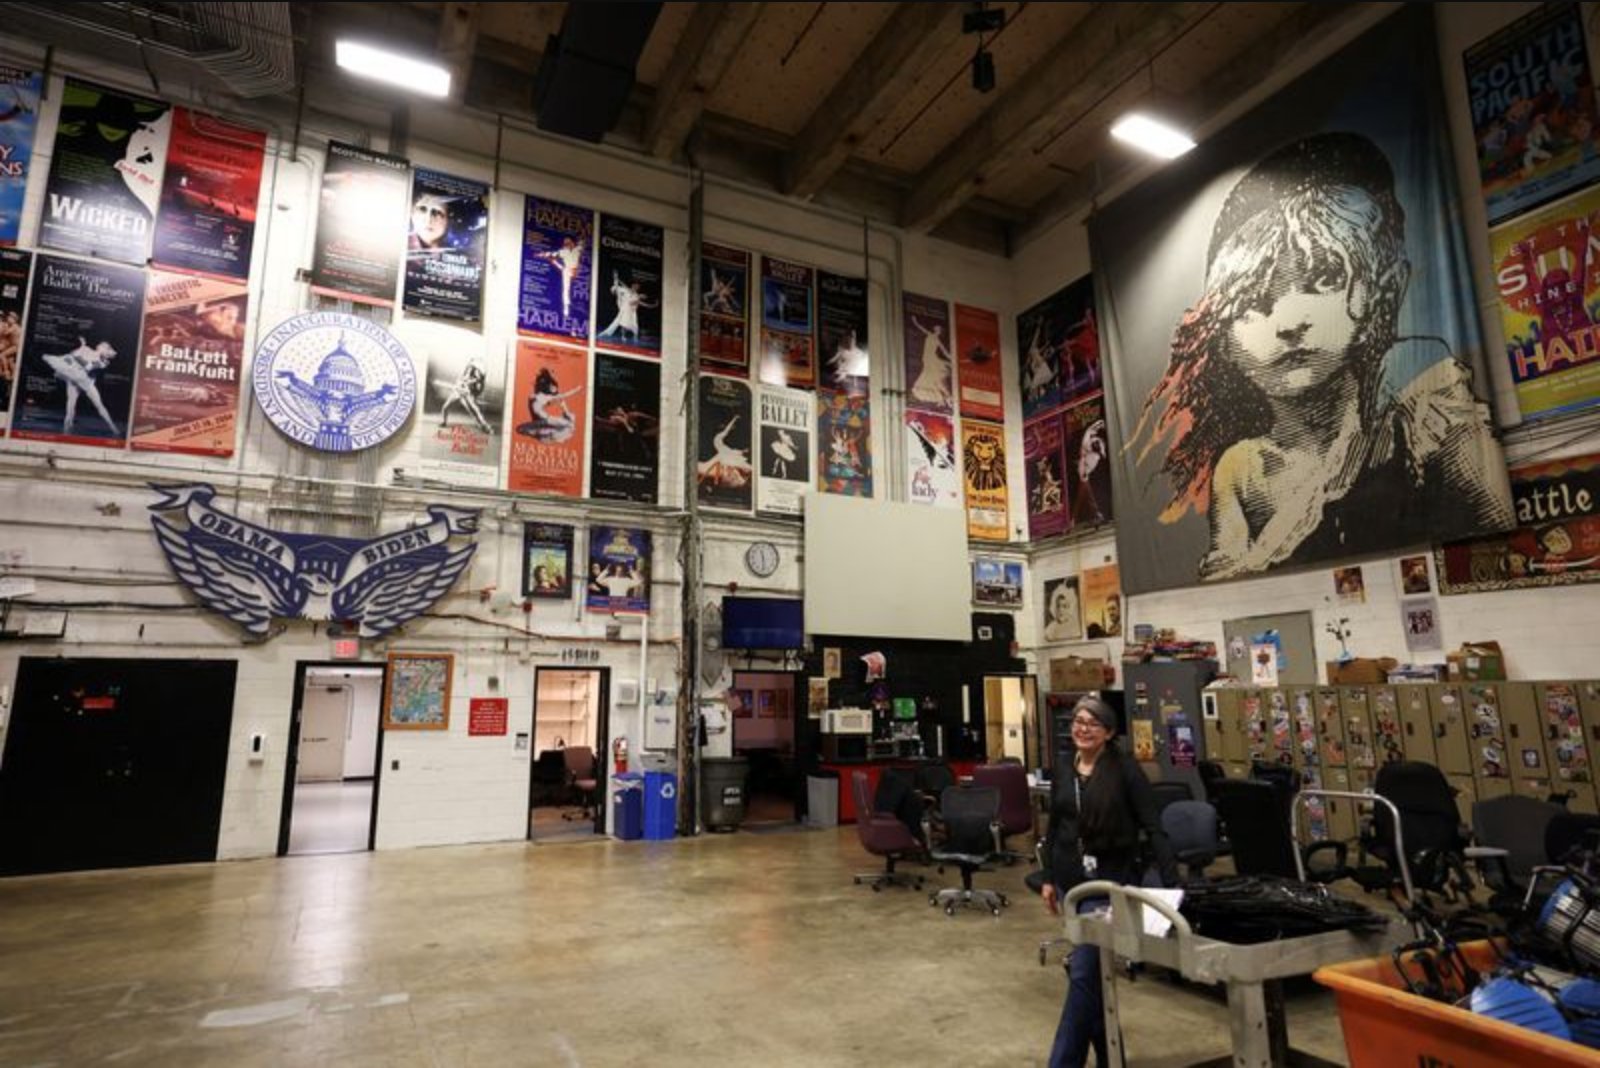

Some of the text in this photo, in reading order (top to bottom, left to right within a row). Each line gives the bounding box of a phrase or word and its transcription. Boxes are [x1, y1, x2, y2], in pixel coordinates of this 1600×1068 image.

[1471, 17, 1583, 100] SOUTH
[1472, 46, 1586, 125] PACIFIC
[601, 235, 661, 259] Cinderella
[43, 274, 135, 299] Ballet Theatre
[44, 264, 110, 286] American
[274, 313, 404, 360] INAUGURATION OF
[517, 306, 590, 337] HARLEM
[1515, 325, 1600, 378] HAI
[278, 417, 314, 446] AND
[352, 427, 386, 447] VICE
[760, 403, 810, 428] BALLET
[1516, 482, 1593, 522] attle
[198, 511, 432, 565] OBAMA BIDEN
